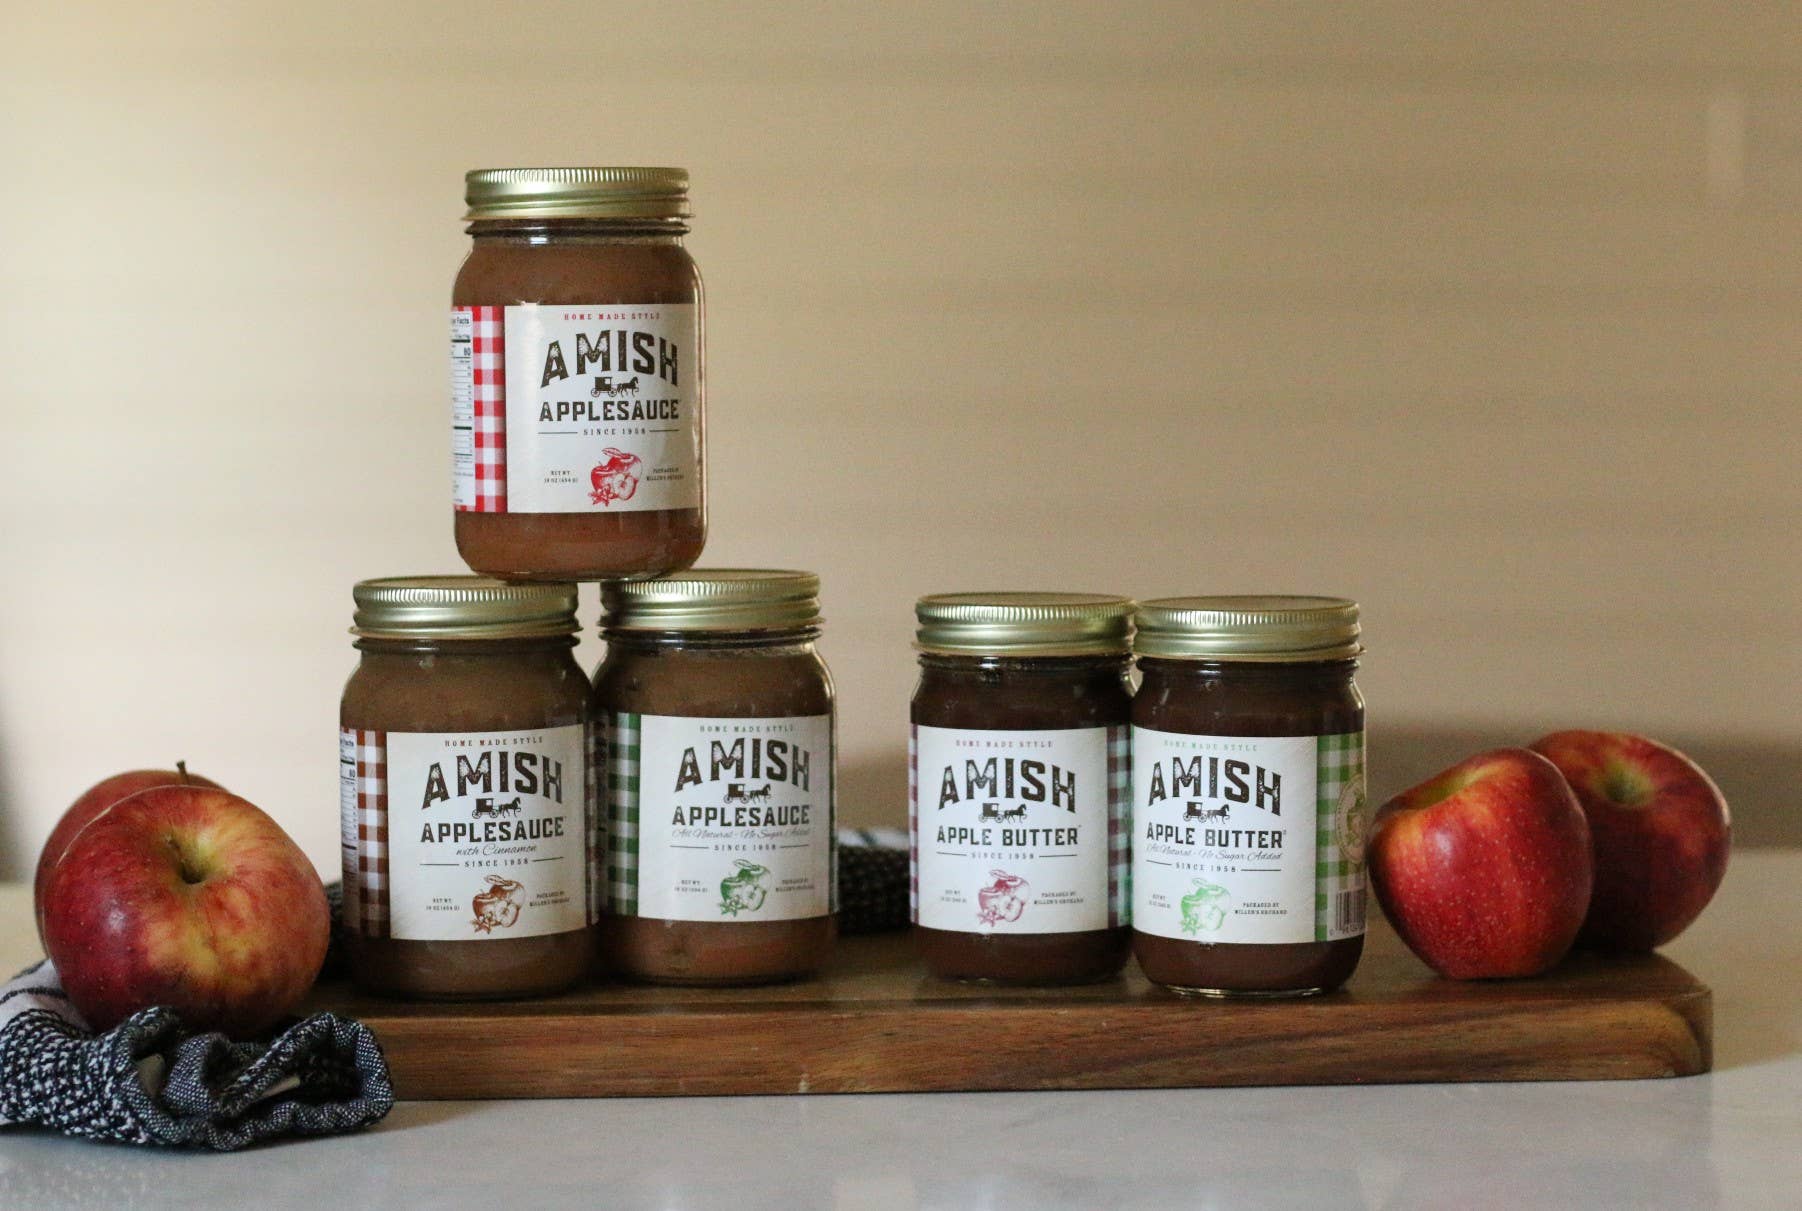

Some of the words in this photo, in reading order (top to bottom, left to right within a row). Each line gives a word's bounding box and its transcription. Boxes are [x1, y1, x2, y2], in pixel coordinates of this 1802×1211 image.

[631, 312, 660, 320] STYLE
[541, 330, 678, 388] AMISH
[539, 399, 679, 421] APPLESAUCE
[583, 428, 616, 436] SINCE
[444, 739, 473, 747] HOME
[479, 738, 507, 746] MADE
[513, 736, 543, 745] STYLE
[986, 740, 1013, 748] MADE
[674, 737, 810, 792] AMISH
[422, 751, 562, 810] AMISH
[939, 757, 1075, 813] AMISH
[1148, 755, 1281, 816] AMISH
[672, 804, 810, 827] APPLESAUCE
[420, 817, 564, 843] APPLESAUCE
[937, 825, 992, 846] APPLE
[1002, 827, 1078, 846] BUTTER
[1147, 822, 1195, 846] APPLE
[1205, 829, 1283, 849] BUTTER
[456, 846, 479, 856] with
[482, 843, 537, 856] Cinnamon
[1215, 850, 1245, 861] Sugar
[1247, 850, 1283, 861] Added
[465, 860, 498, 868] SINCE
[504, 858, 529, 866] 1958
[1175, 862, 1204, 871] SINCE
